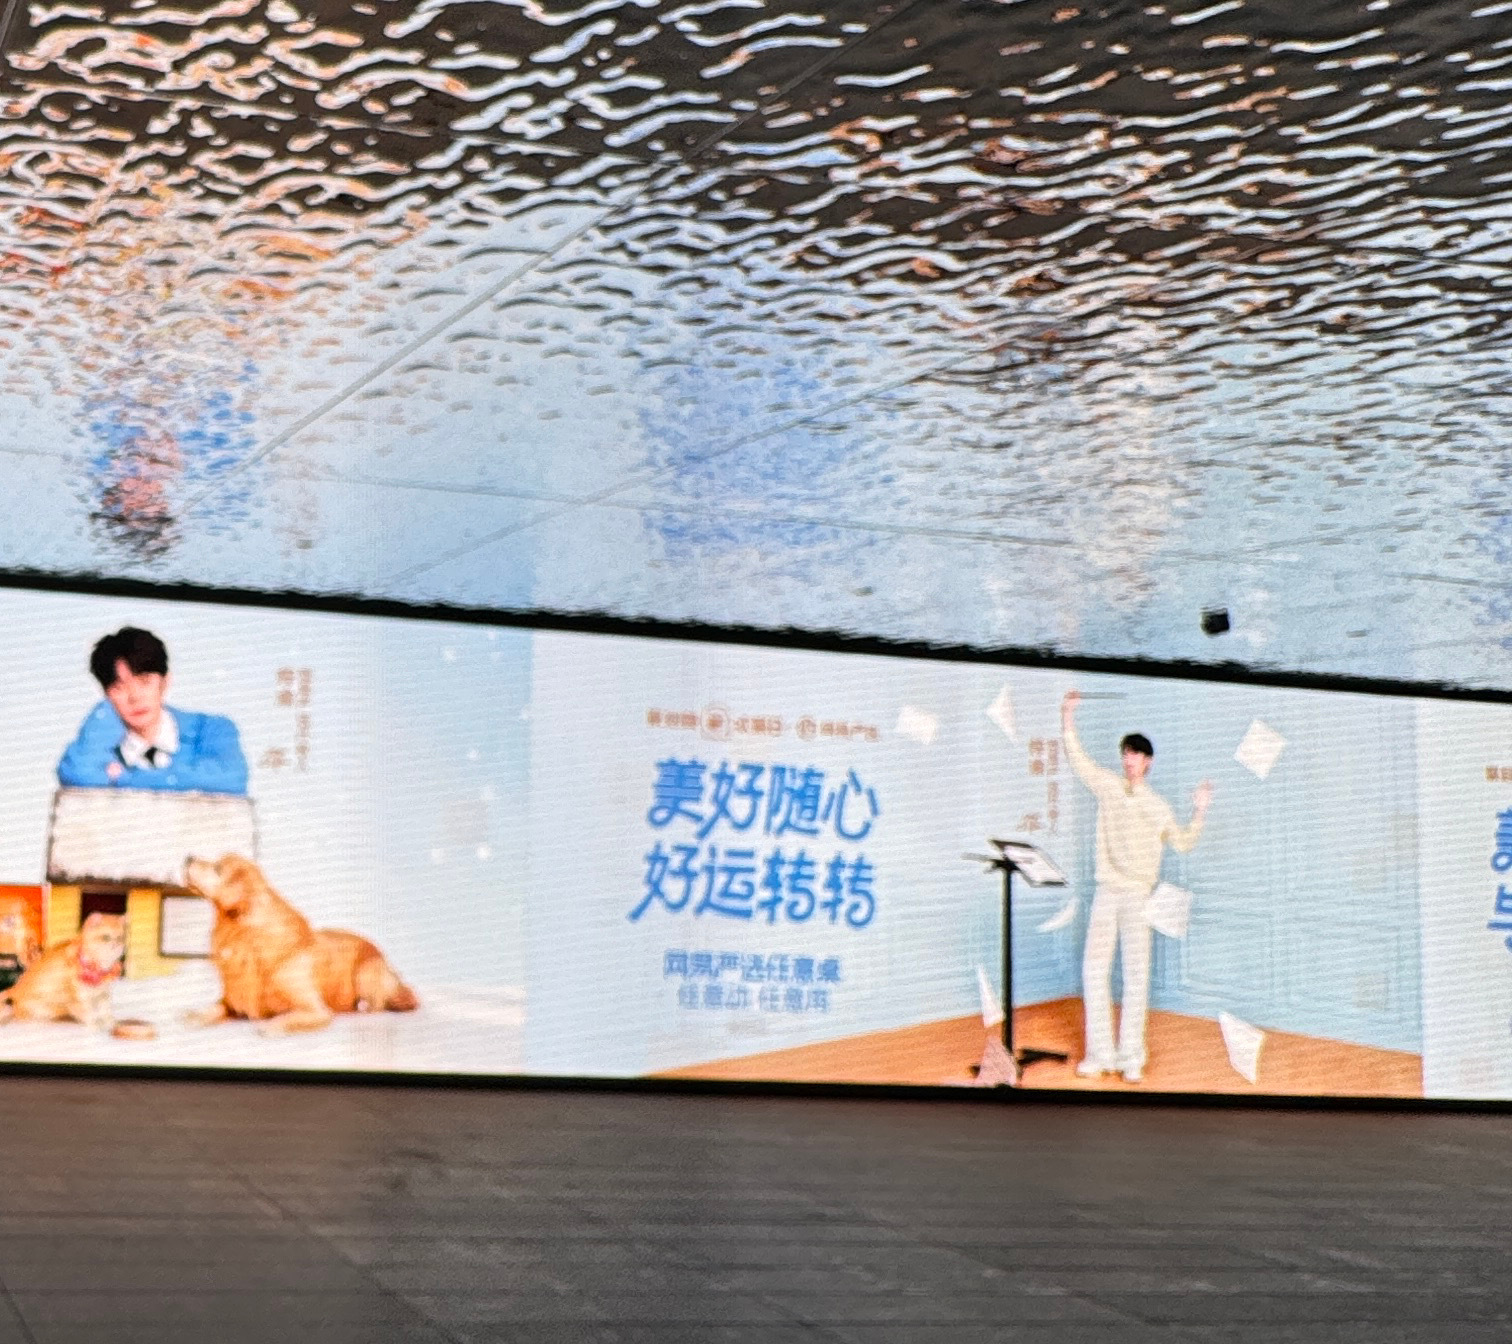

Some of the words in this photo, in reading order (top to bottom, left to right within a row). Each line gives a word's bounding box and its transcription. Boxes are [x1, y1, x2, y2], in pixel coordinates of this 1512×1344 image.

[645, 755, 882, 843] 美好随心
[626, 840, 878, 931] 好运转转
